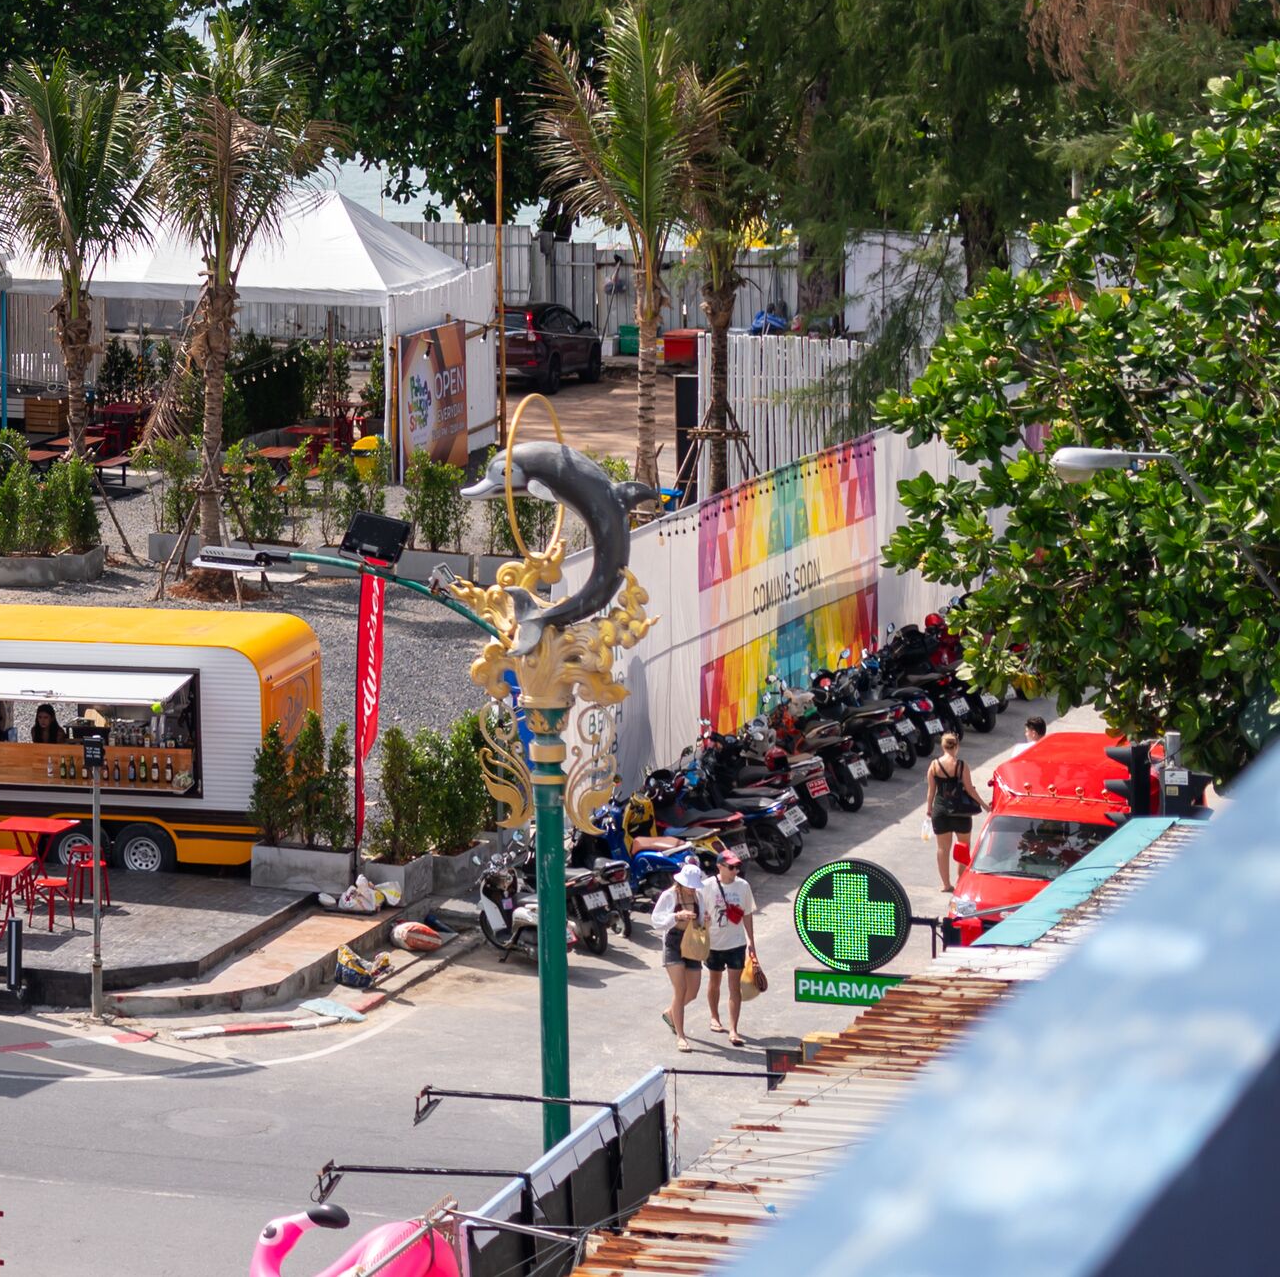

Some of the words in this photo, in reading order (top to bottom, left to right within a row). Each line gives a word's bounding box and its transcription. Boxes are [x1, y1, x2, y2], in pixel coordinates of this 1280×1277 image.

[434, 365, 464, 400] OPEN
[753, 571, 791, 615] COMING
[793, 556, 821, 596] SOON
[798, 979, 896, 1000] PHARMAC
